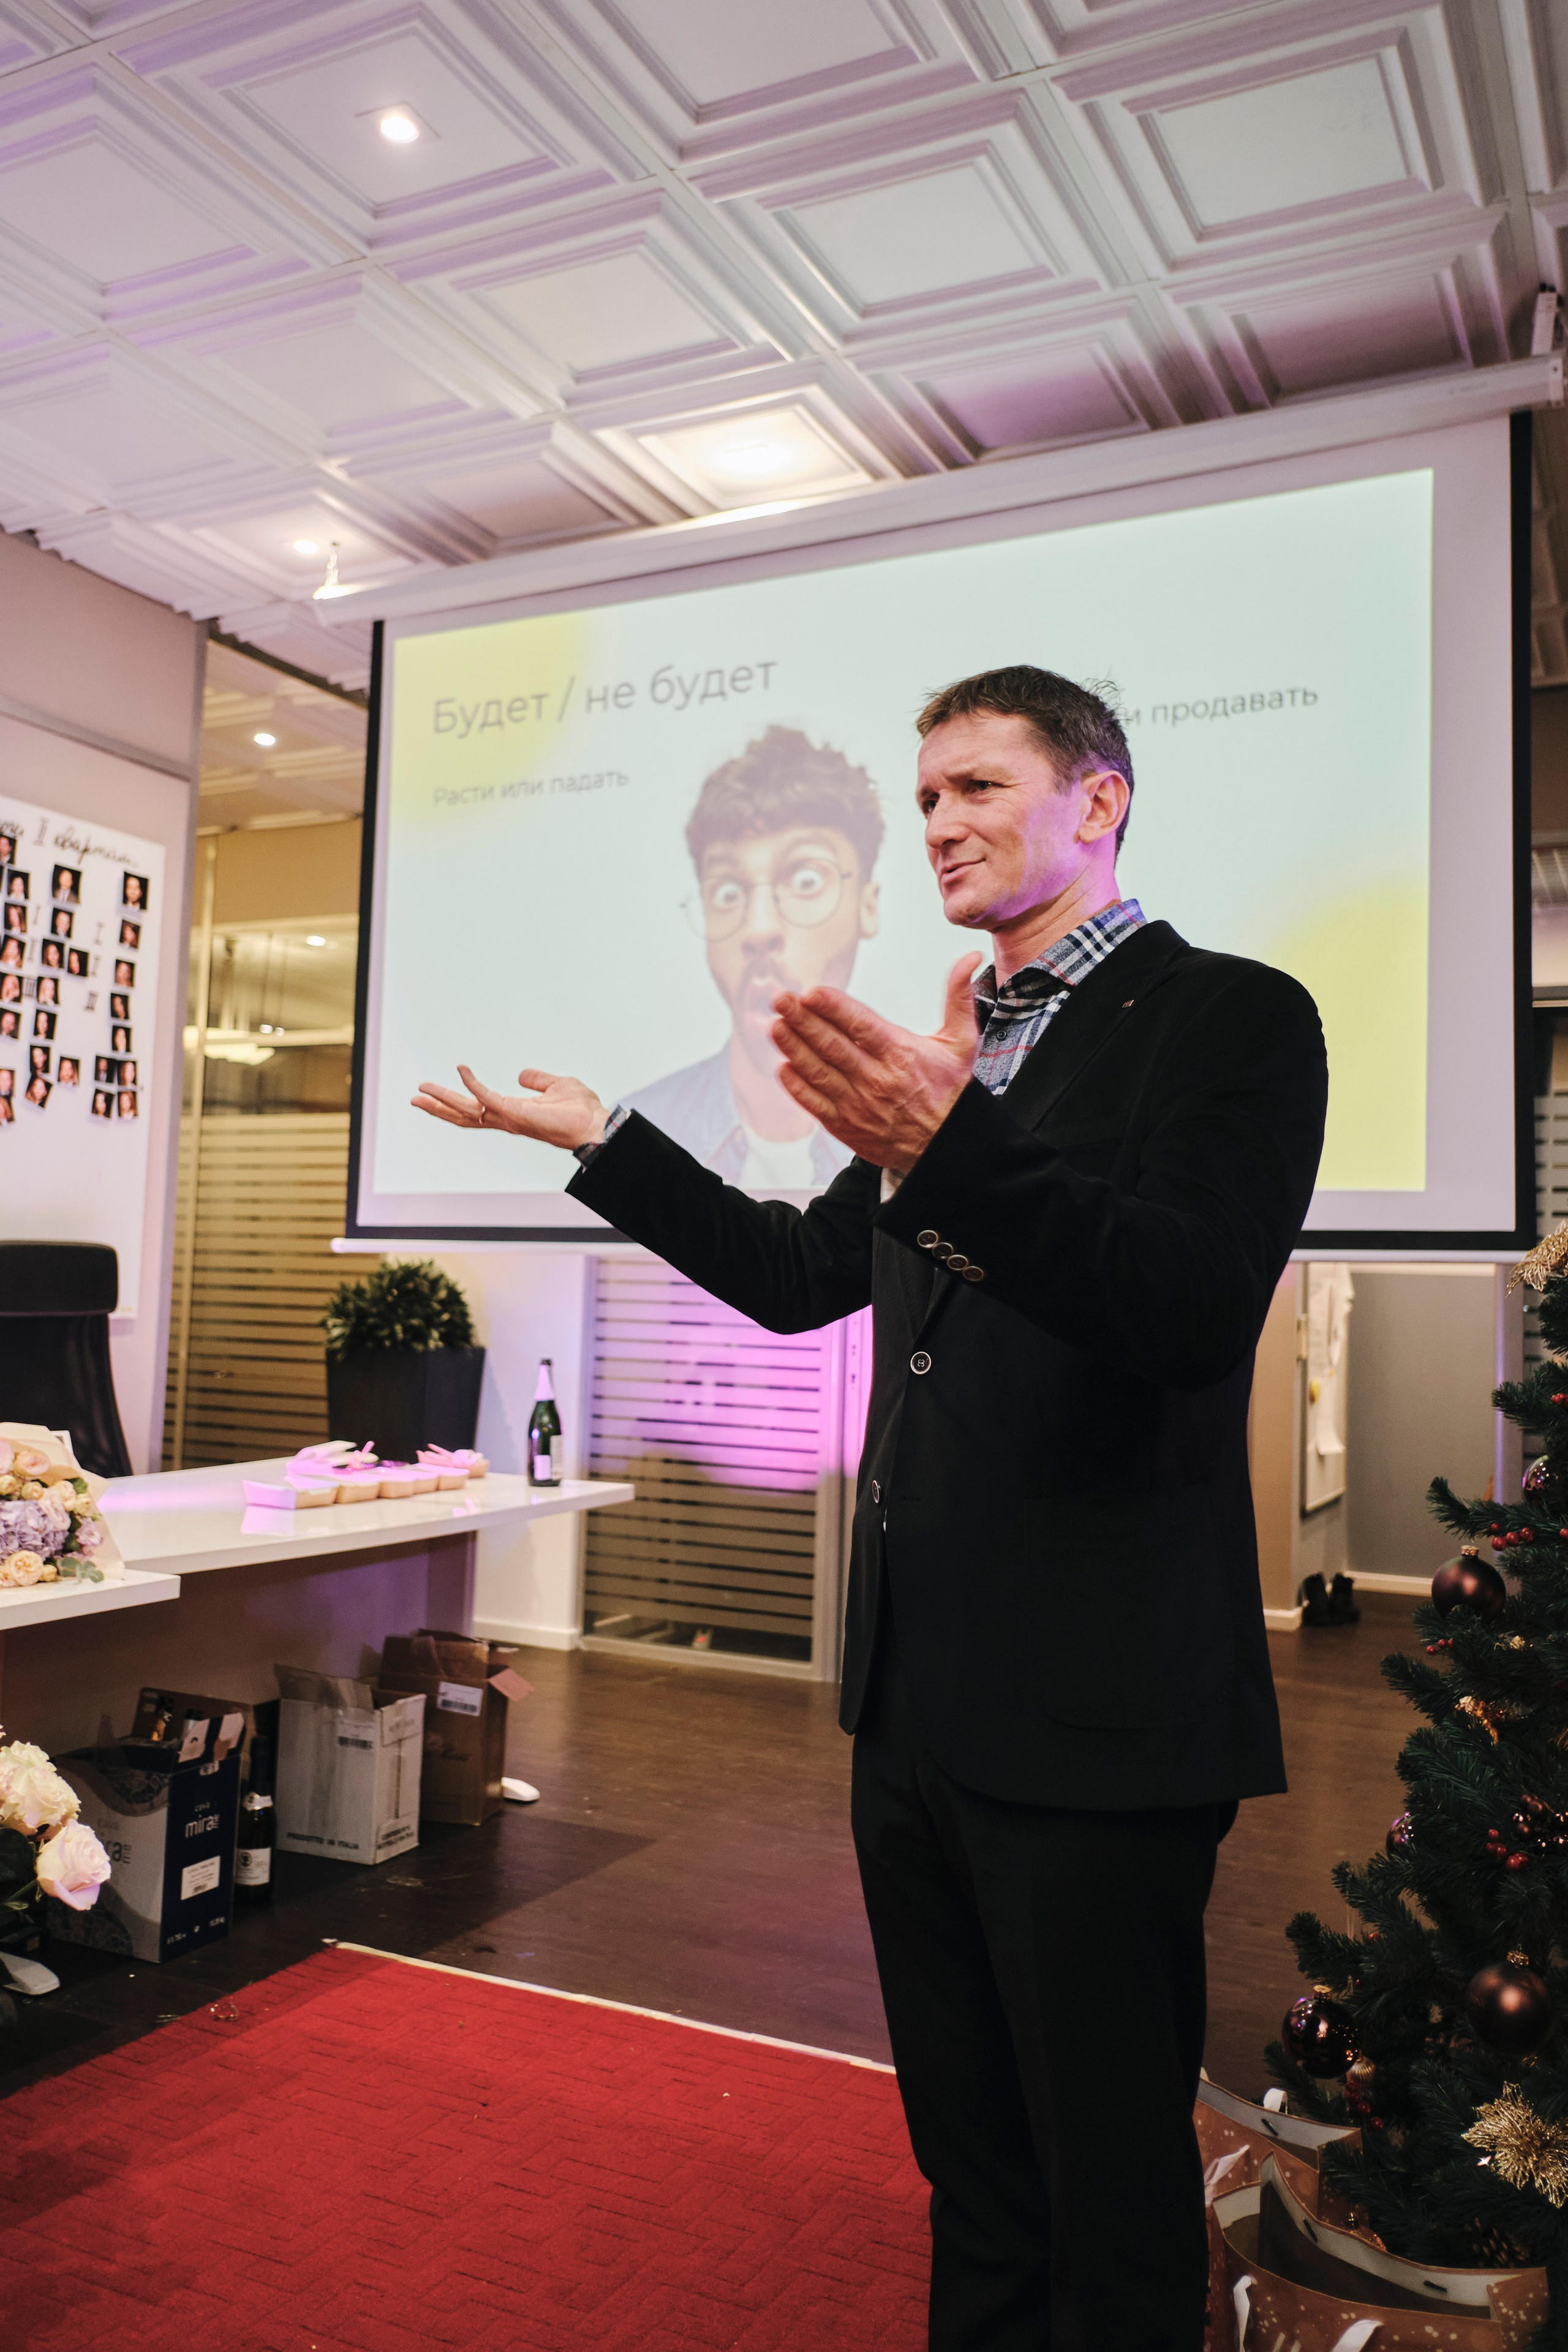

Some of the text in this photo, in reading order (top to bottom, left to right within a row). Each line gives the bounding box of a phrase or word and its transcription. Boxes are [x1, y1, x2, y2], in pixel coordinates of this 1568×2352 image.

[433, 661, 778, 739] Будет / не будет
[1152, 687, 1319, 728] продавать
[432, 770, 630, 807] Расти или падать
